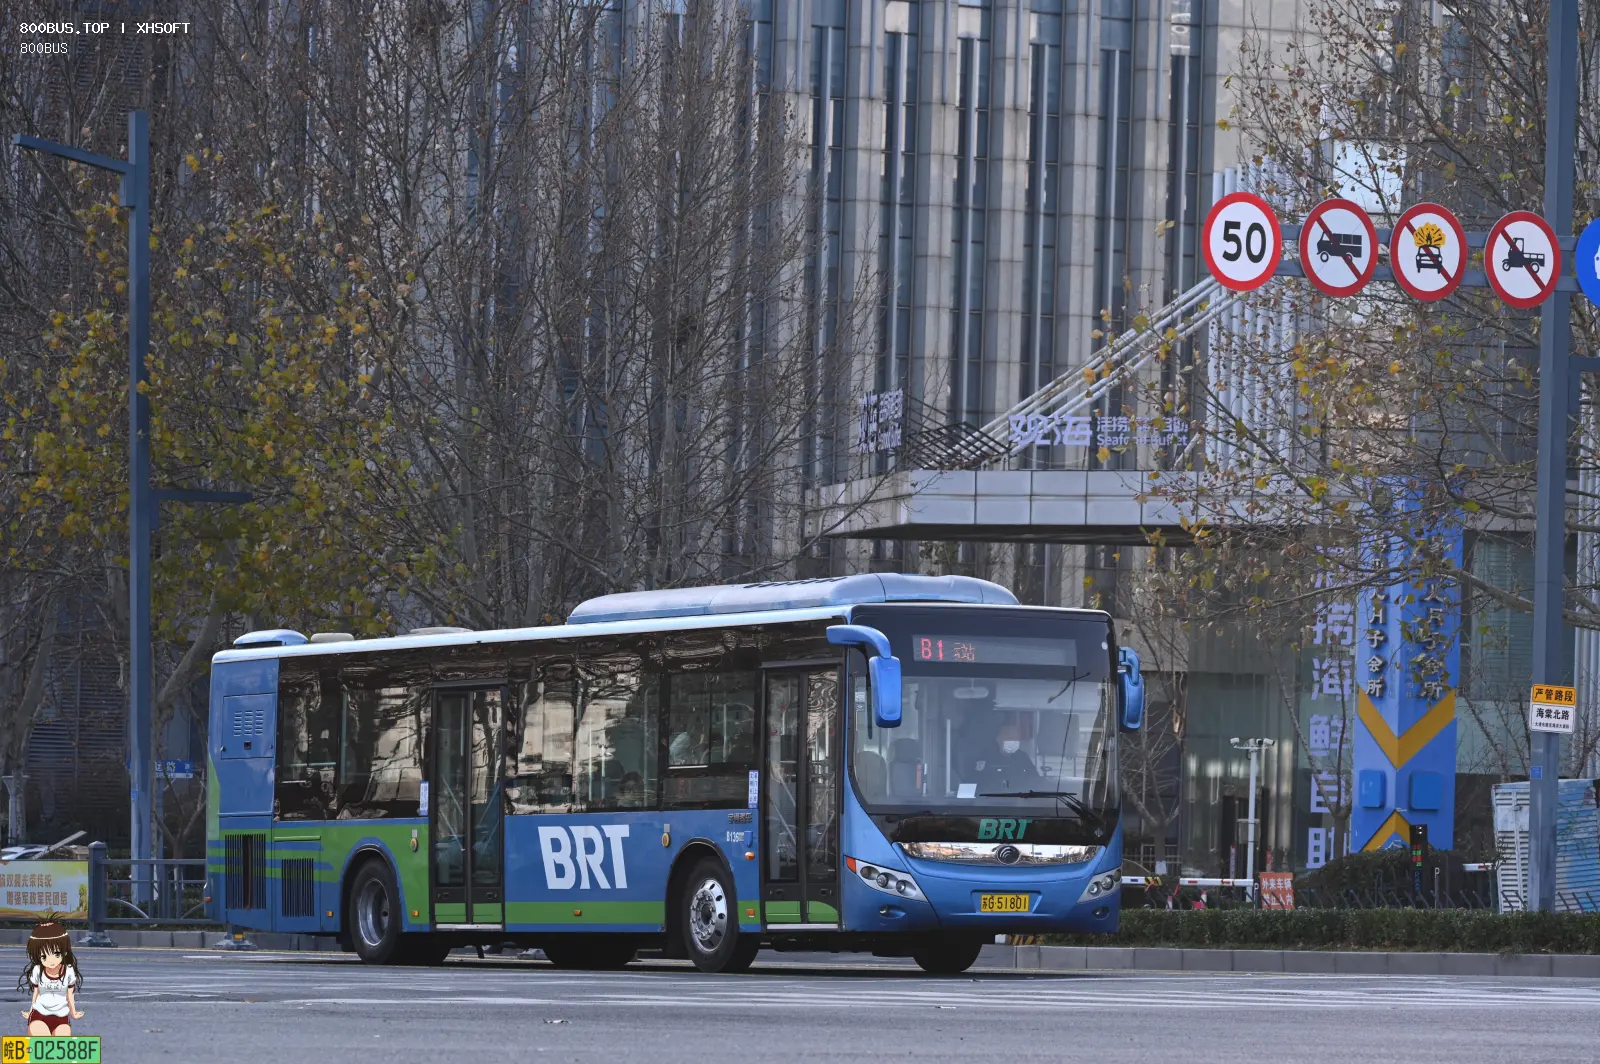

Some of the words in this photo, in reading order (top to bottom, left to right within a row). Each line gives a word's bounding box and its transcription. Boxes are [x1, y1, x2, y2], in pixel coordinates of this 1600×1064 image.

[1222, 220, 1267, 263] 50
[1008, 414, 1093, 446] 观海
[1096, 416, 1189, 432] 活捞自助
[920, 637, 945, 661] B1
[1534, 688, 1573, 702] 严管路段
[1535, 707, 1570, 721] 海棠北路
[977, 818, 1032, 840] BRT
[537, 823, 630, 890] BRT
[1261, 877, 1292, 891] 外来车辆
[6, 890, 68, 906] 增强军政军民团结
